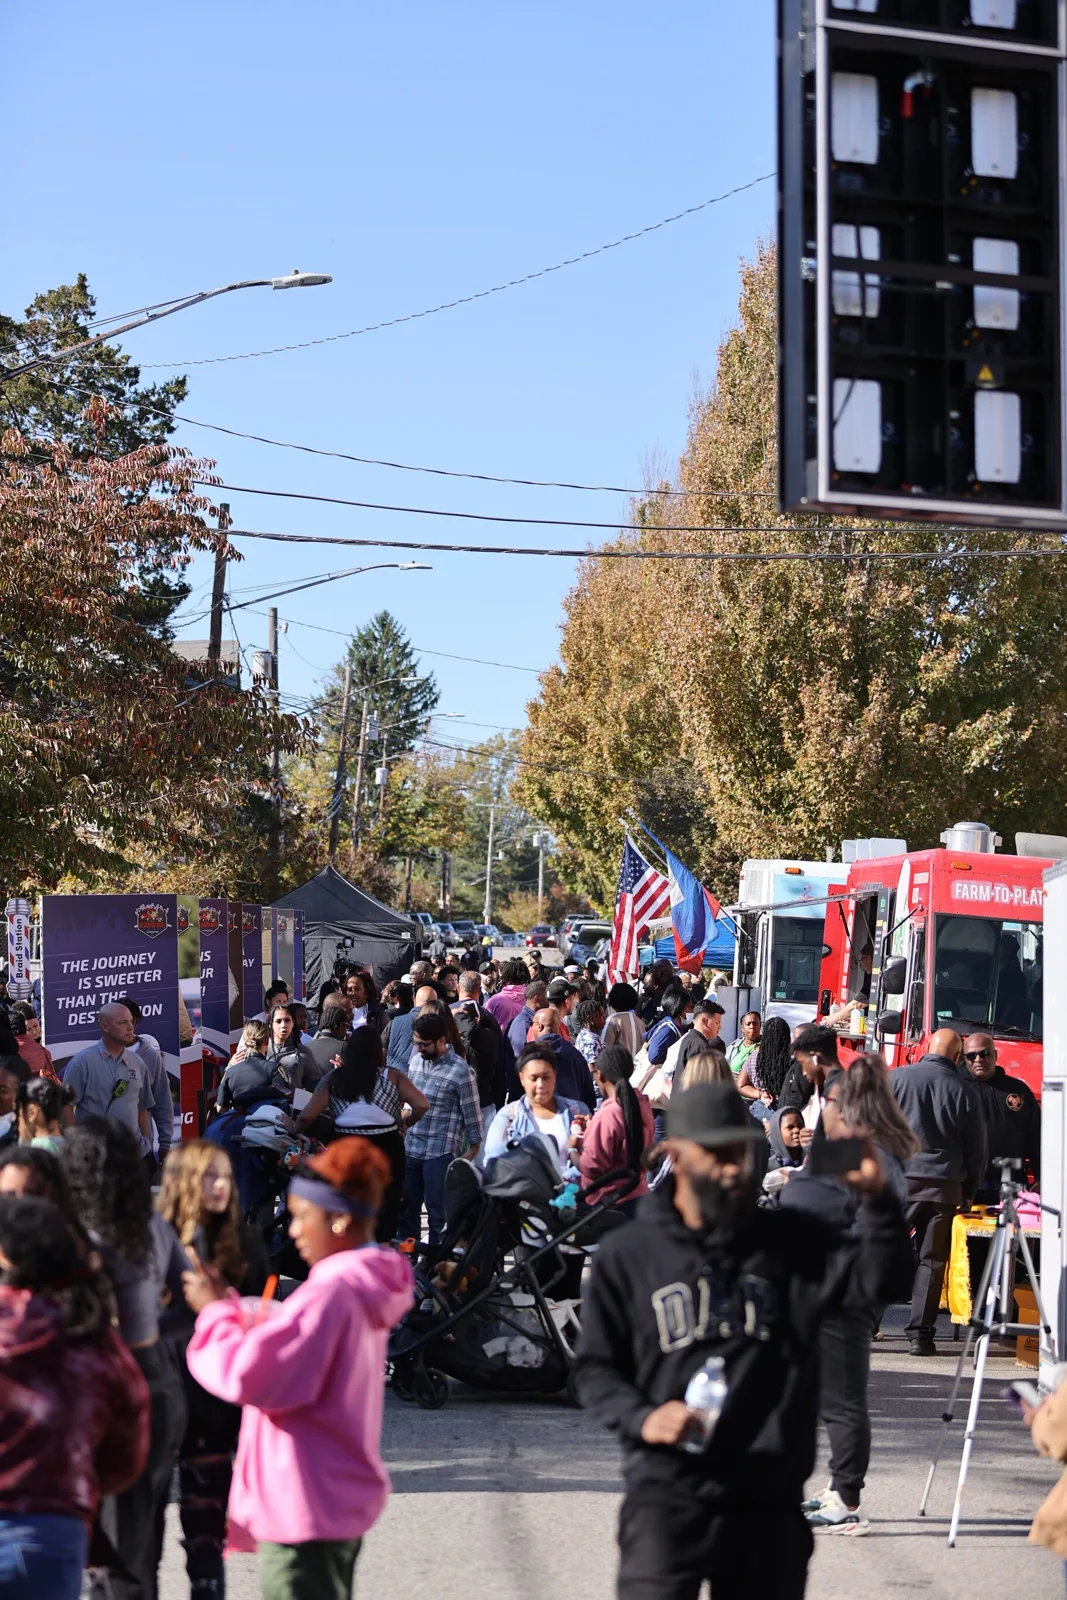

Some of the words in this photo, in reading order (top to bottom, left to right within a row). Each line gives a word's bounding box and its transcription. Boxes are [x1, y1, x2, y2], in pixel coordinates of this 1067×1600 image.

[15, 918, 23, 951] Station
[15, 953, 24, 979] Braid
[61, 959, 90, 974] THE
[91, 951, 157, 971] JOURNEY
[78, 976, 92, 990] IS
[94, 969, 162, 989] SWEETER
[56, 993, 97, 1010] THAN
